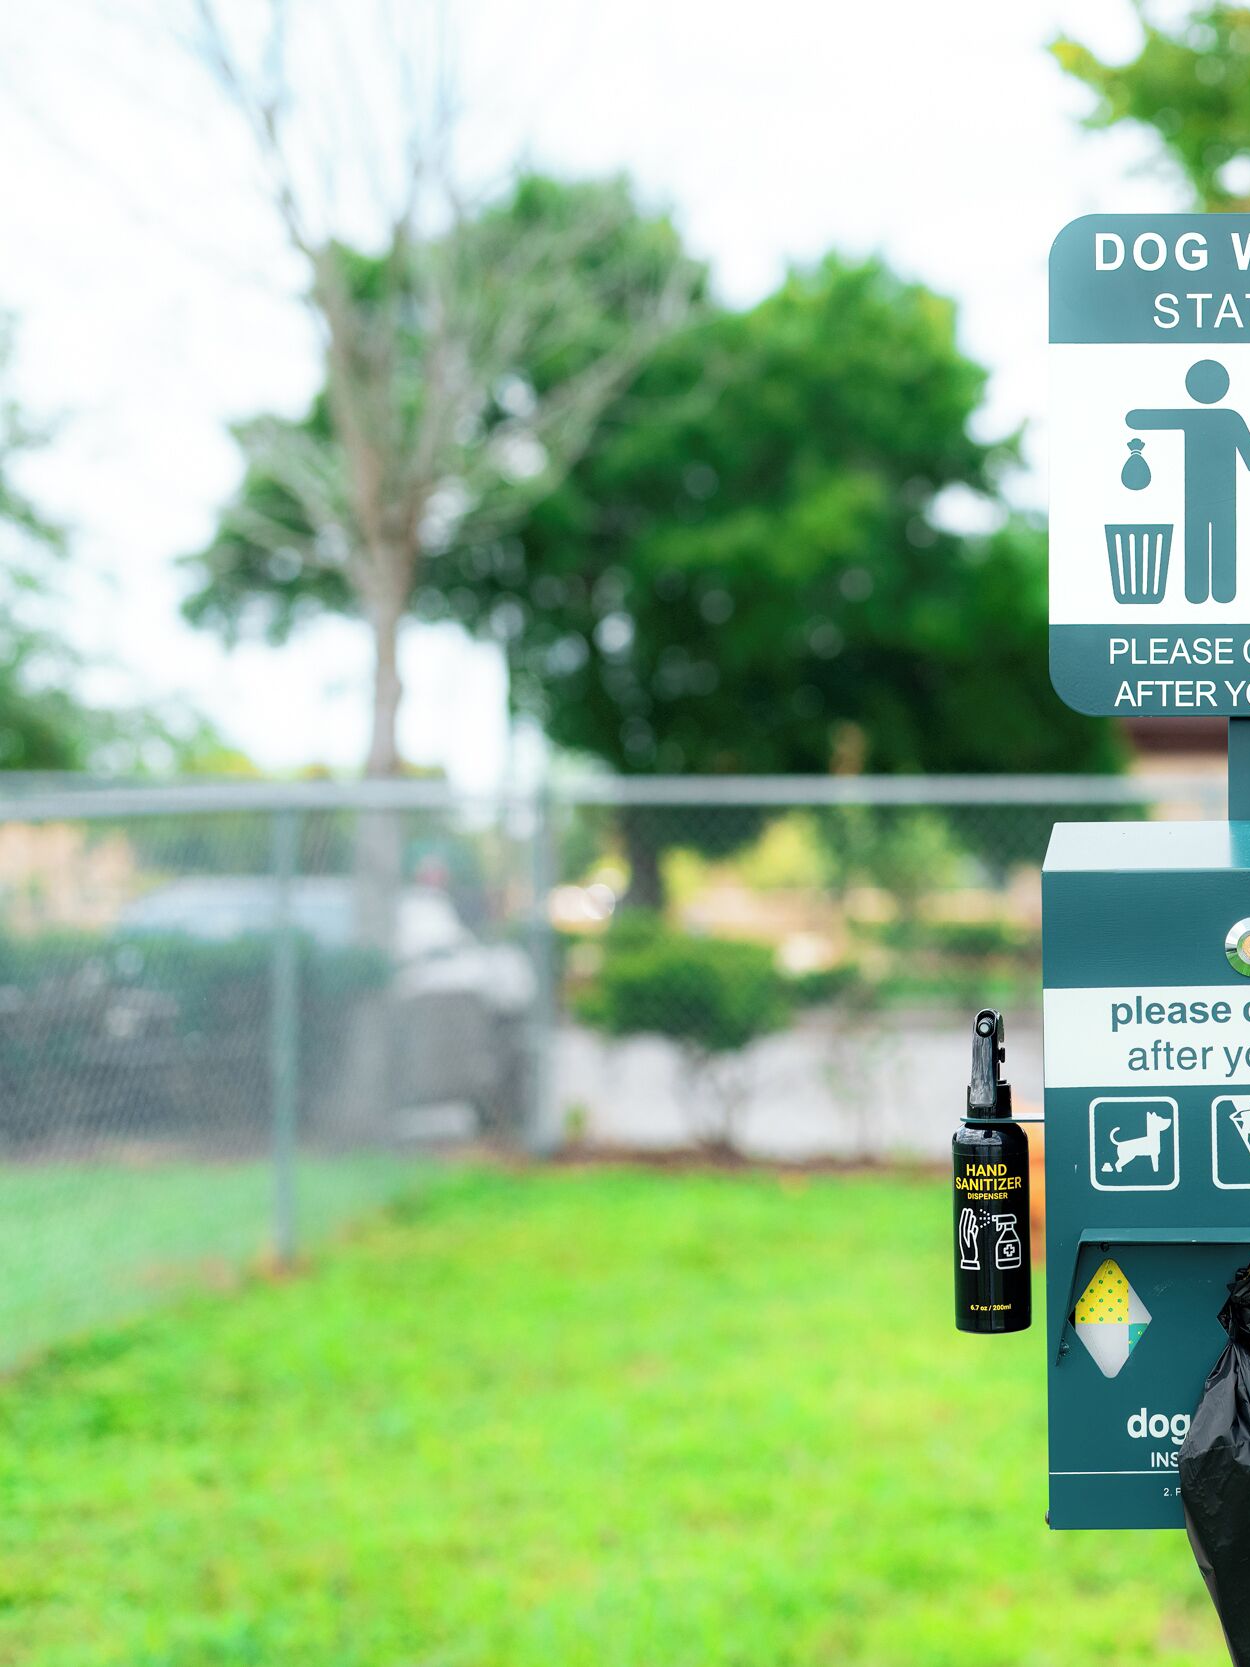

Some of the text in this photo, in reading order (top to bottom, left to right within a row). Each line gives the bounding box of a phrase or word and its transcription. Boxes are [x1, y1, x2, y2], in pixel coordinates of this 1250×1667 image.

[1095, 232, 1208, 272] DOG
[1109, 637, 1234, 665] PLEASE
[1113, 680, 1218, 707] AFTER
[1111, 995, 1232, 1033] please
[1127, 1039, 1214, 1072] after
[955, 1176, 1022, 1191] SANITIZER
[966, 1163, 1008, 1177] HAND
[967, 1192, 1008, 1200] DISPENSER
[1126, 1407, 1191, 1446] dog
[1163, 1487, 1173, 1497] 2.
